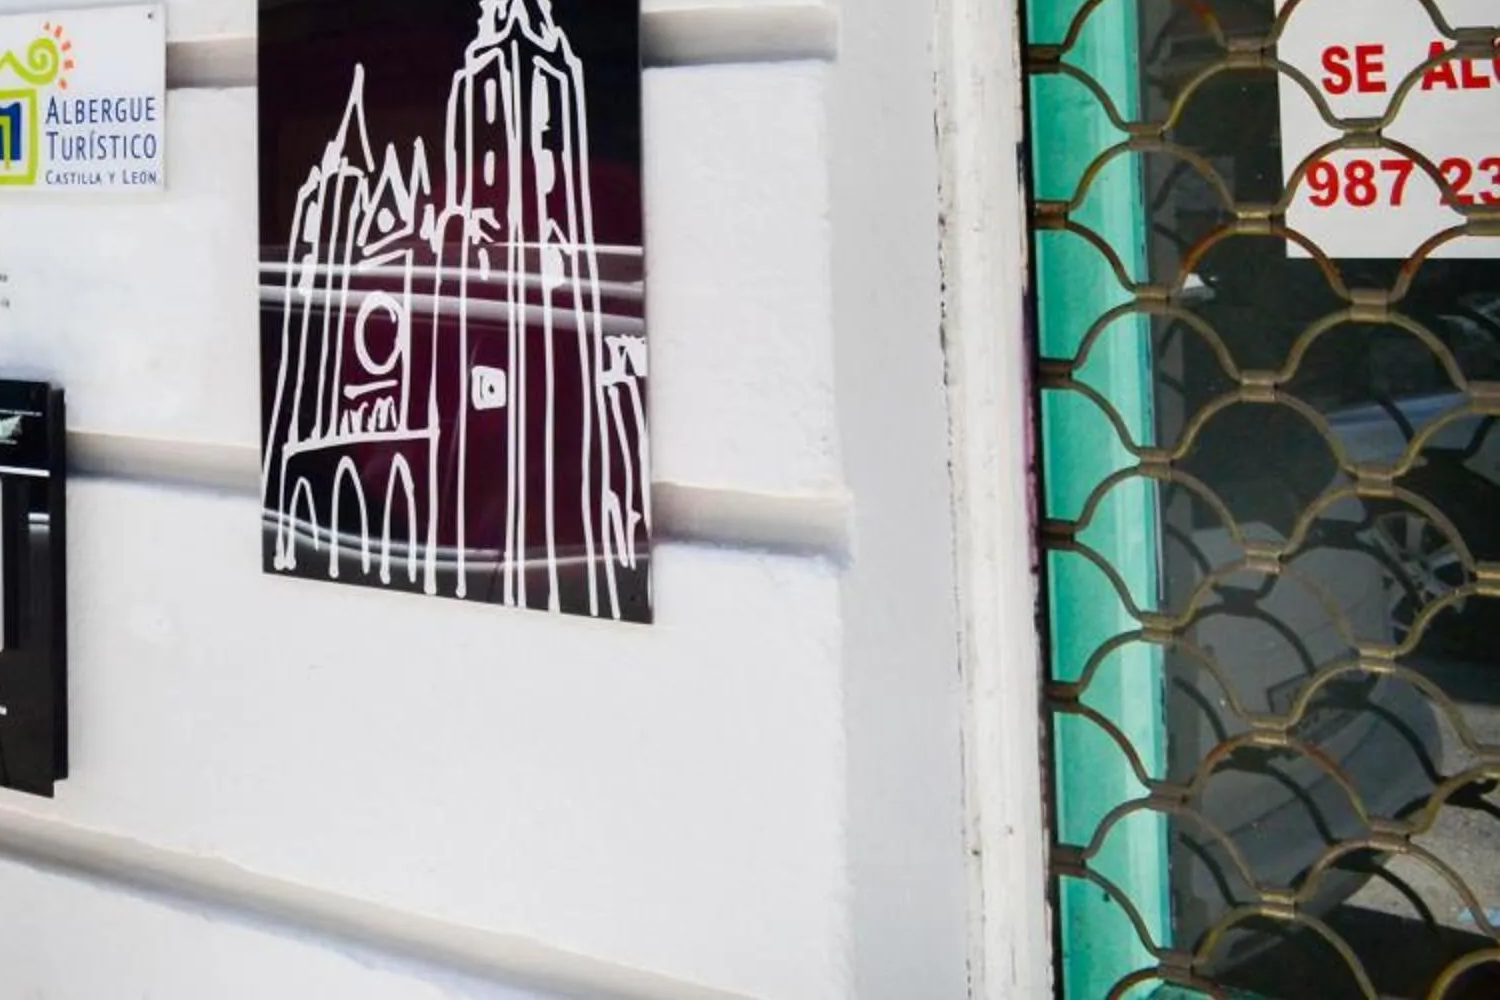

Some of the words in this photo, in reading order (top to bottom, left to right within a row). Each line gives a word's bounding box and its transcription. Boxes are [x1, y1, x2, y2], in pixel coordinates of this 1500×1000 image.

[1321, 45, 1387, 95] SE
[1421, 40, 1500, 90] AL
[45, 96, 156, 125] ALBERGUE
[45, 130, 157, 162] TURÍSTICO
[1305, 159, 1415, 208] 987
